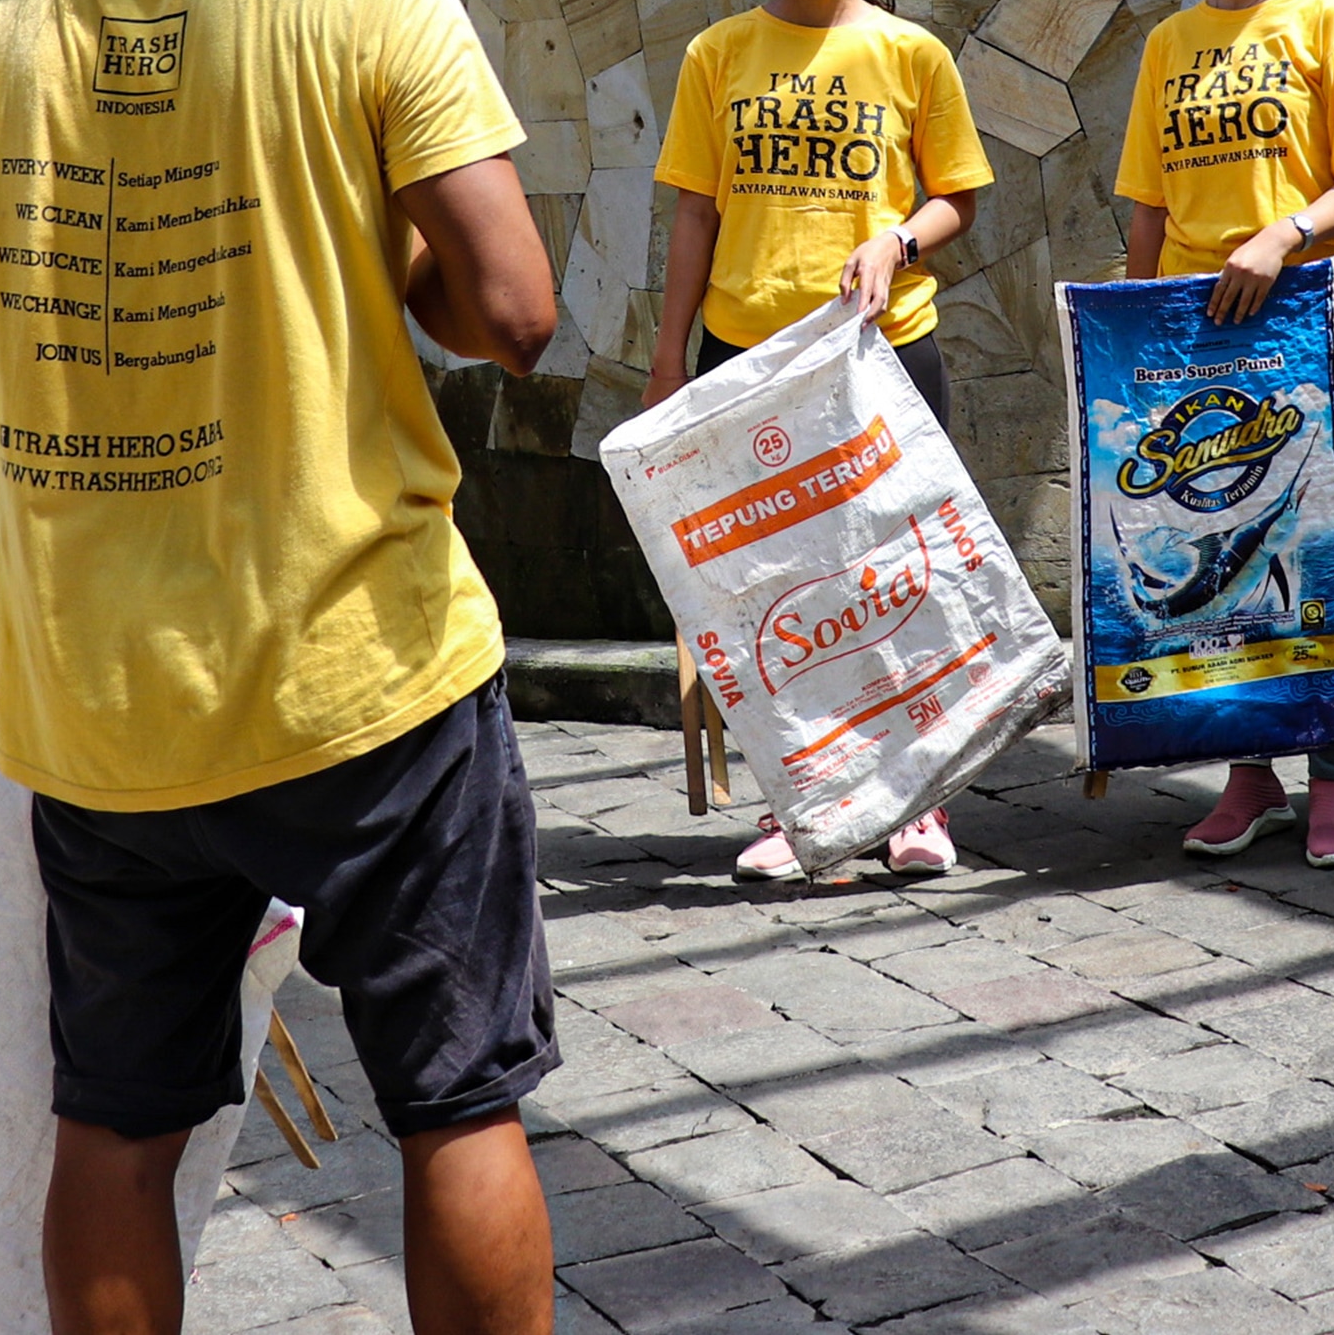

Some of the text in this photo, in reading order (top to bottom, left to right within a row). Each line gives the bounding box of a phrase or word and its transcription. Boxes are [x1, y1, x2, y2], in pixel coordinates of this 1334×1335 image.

[107, 32, 179, 54] TRASH
[1191, 43, 1260, 70] I'M A
[102, 53, 176, 77] HERO
[769, 73, 848, 95] I'M A
[96, 99, 176, 115] INDONESIA
[731, 96, 886, 137] TRASH
[1162, 96, 1289, 153] HERO
[2, 159, 106, 185] EVERY WEEK
[733, 134, 881, 181] HERO
[1185, 150, 1242, 169] PAHLAWAN
[1243, 147, 1288, 161] SAMPAH
[117, 160, 220, 189] Setiap Minggu
[732, 184, 878, 202] SAYA PAHLAWAN SAMPAH
[16, 203, 103, 230] WE CLEAN
[116, 195, 261, 233] Kami Membersihkan
[20, 250, 103, 276] EDUCATE
[114, 240, 252, 278] Kami Mengedukasi
[0, 292, 102, 321] WE CHANGE
[113, 292, 226, 323] Kami Mengubah
[36, 343, 102, 365] JOIN US
[114, 340, 216, 370] Bergabunglah
[1135, 354, 1283, 382] Beras Super Punel
[1175, 394, 1244, 423] IKAN
[13, 428, 101, 457] TRASH
[106, 434, 175, 458] HERO
[759, 433, 784, 456] 25
[770, 452, 783, 463] kg
[1119, 399, 1299, 494] Samudra
[684, 428, 891, 549] TEPUNG TERIGU
[1181, 465, 1264, 508] Kualitas Terjamin
[936, 497, 984, 573] SOVIA
[772, 563, 923, 669] Sovia
[696, 631, 745, 709] SOVIA
[907, 695, 944, 723] SNI
